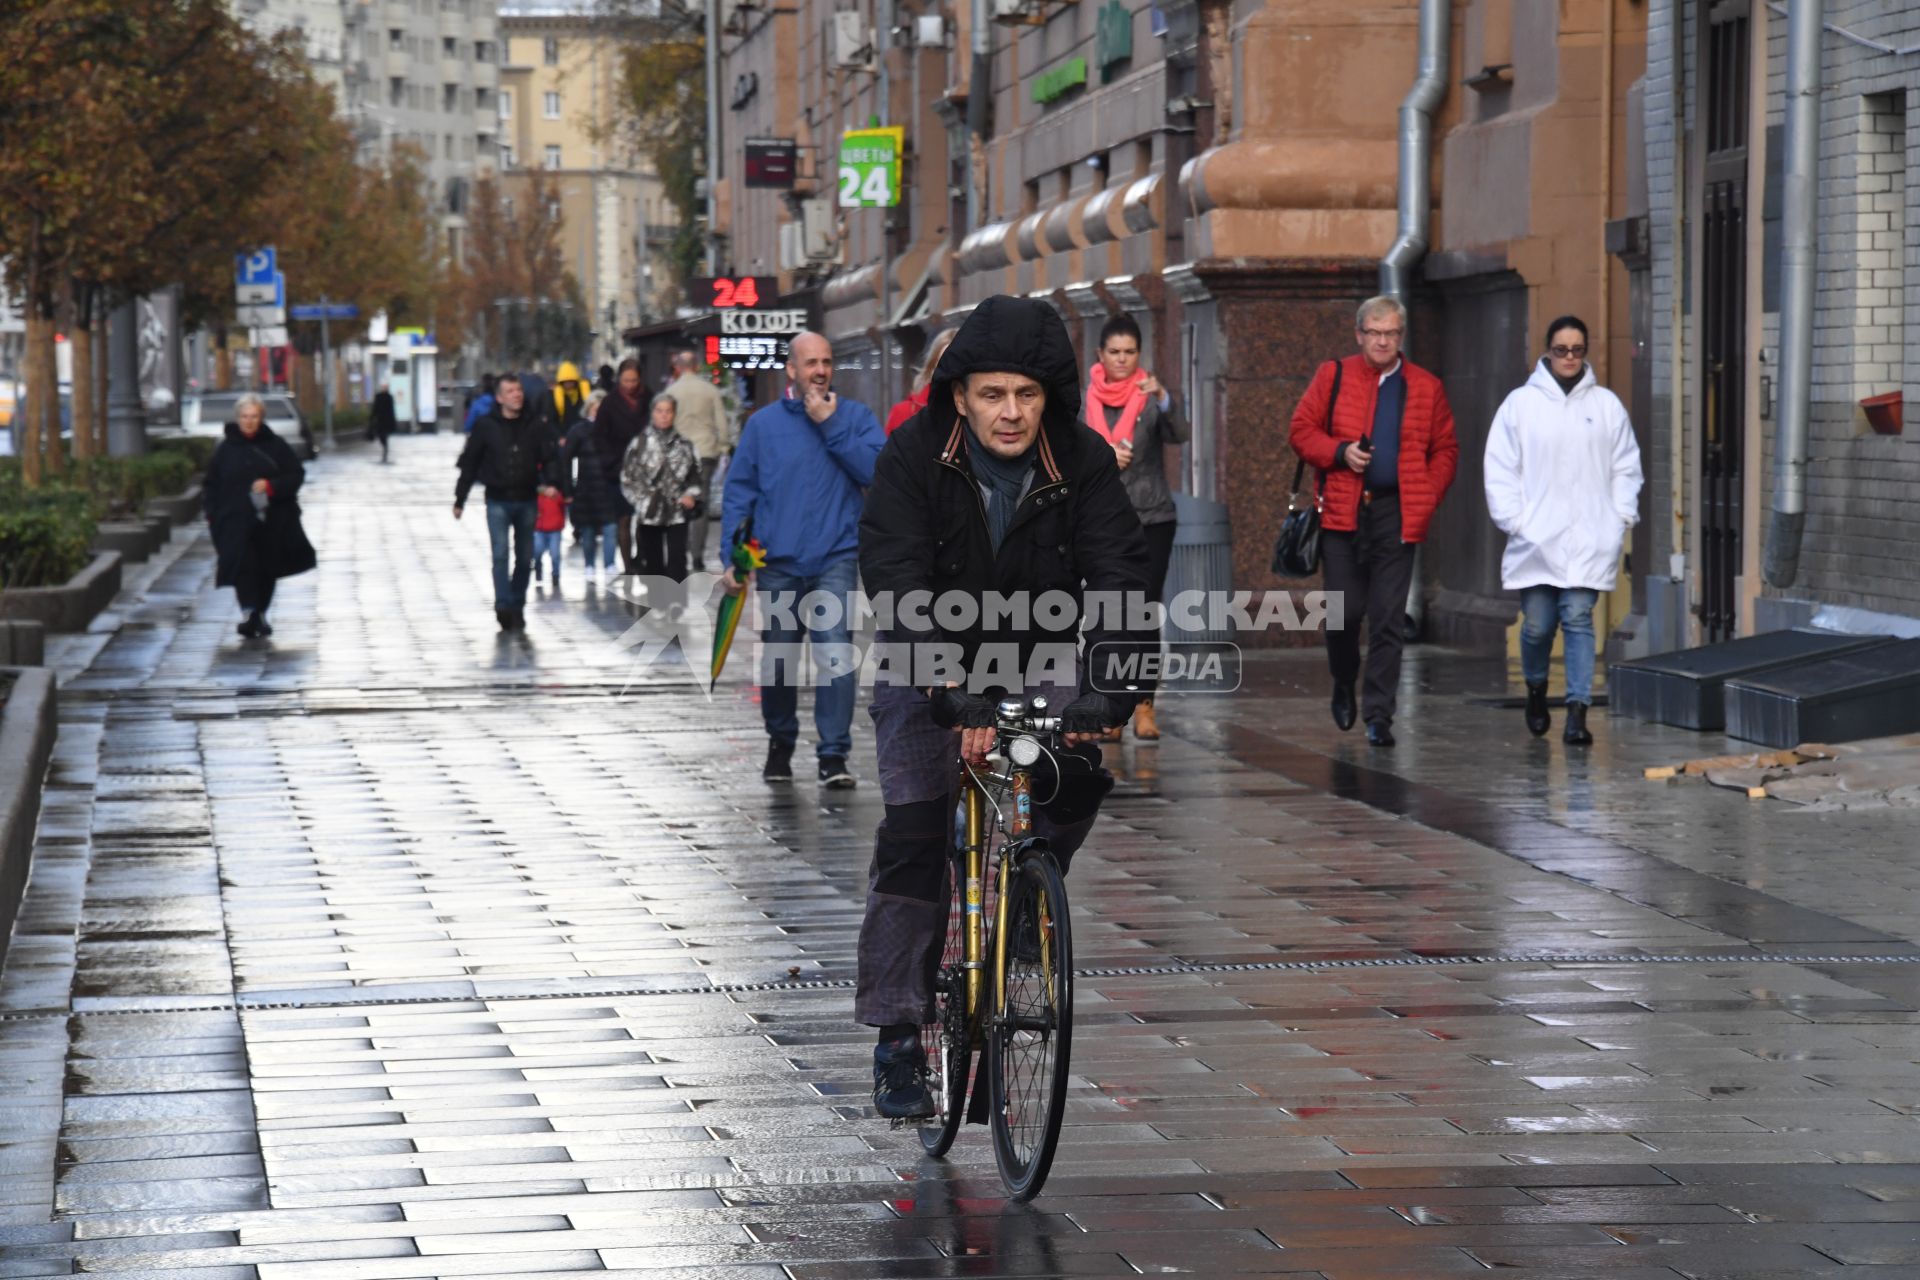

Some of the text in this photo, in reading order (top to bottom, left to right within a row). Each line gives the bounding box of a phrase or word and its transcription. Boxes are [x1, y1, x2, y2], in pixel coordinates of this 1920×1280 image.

[841, 148, 894, 165] ЦВЕТЫ
[840, 166, 892, 208] 24
[712, 277, 759, 307] 24
[720, 309, 808, 333] КОФЕ
